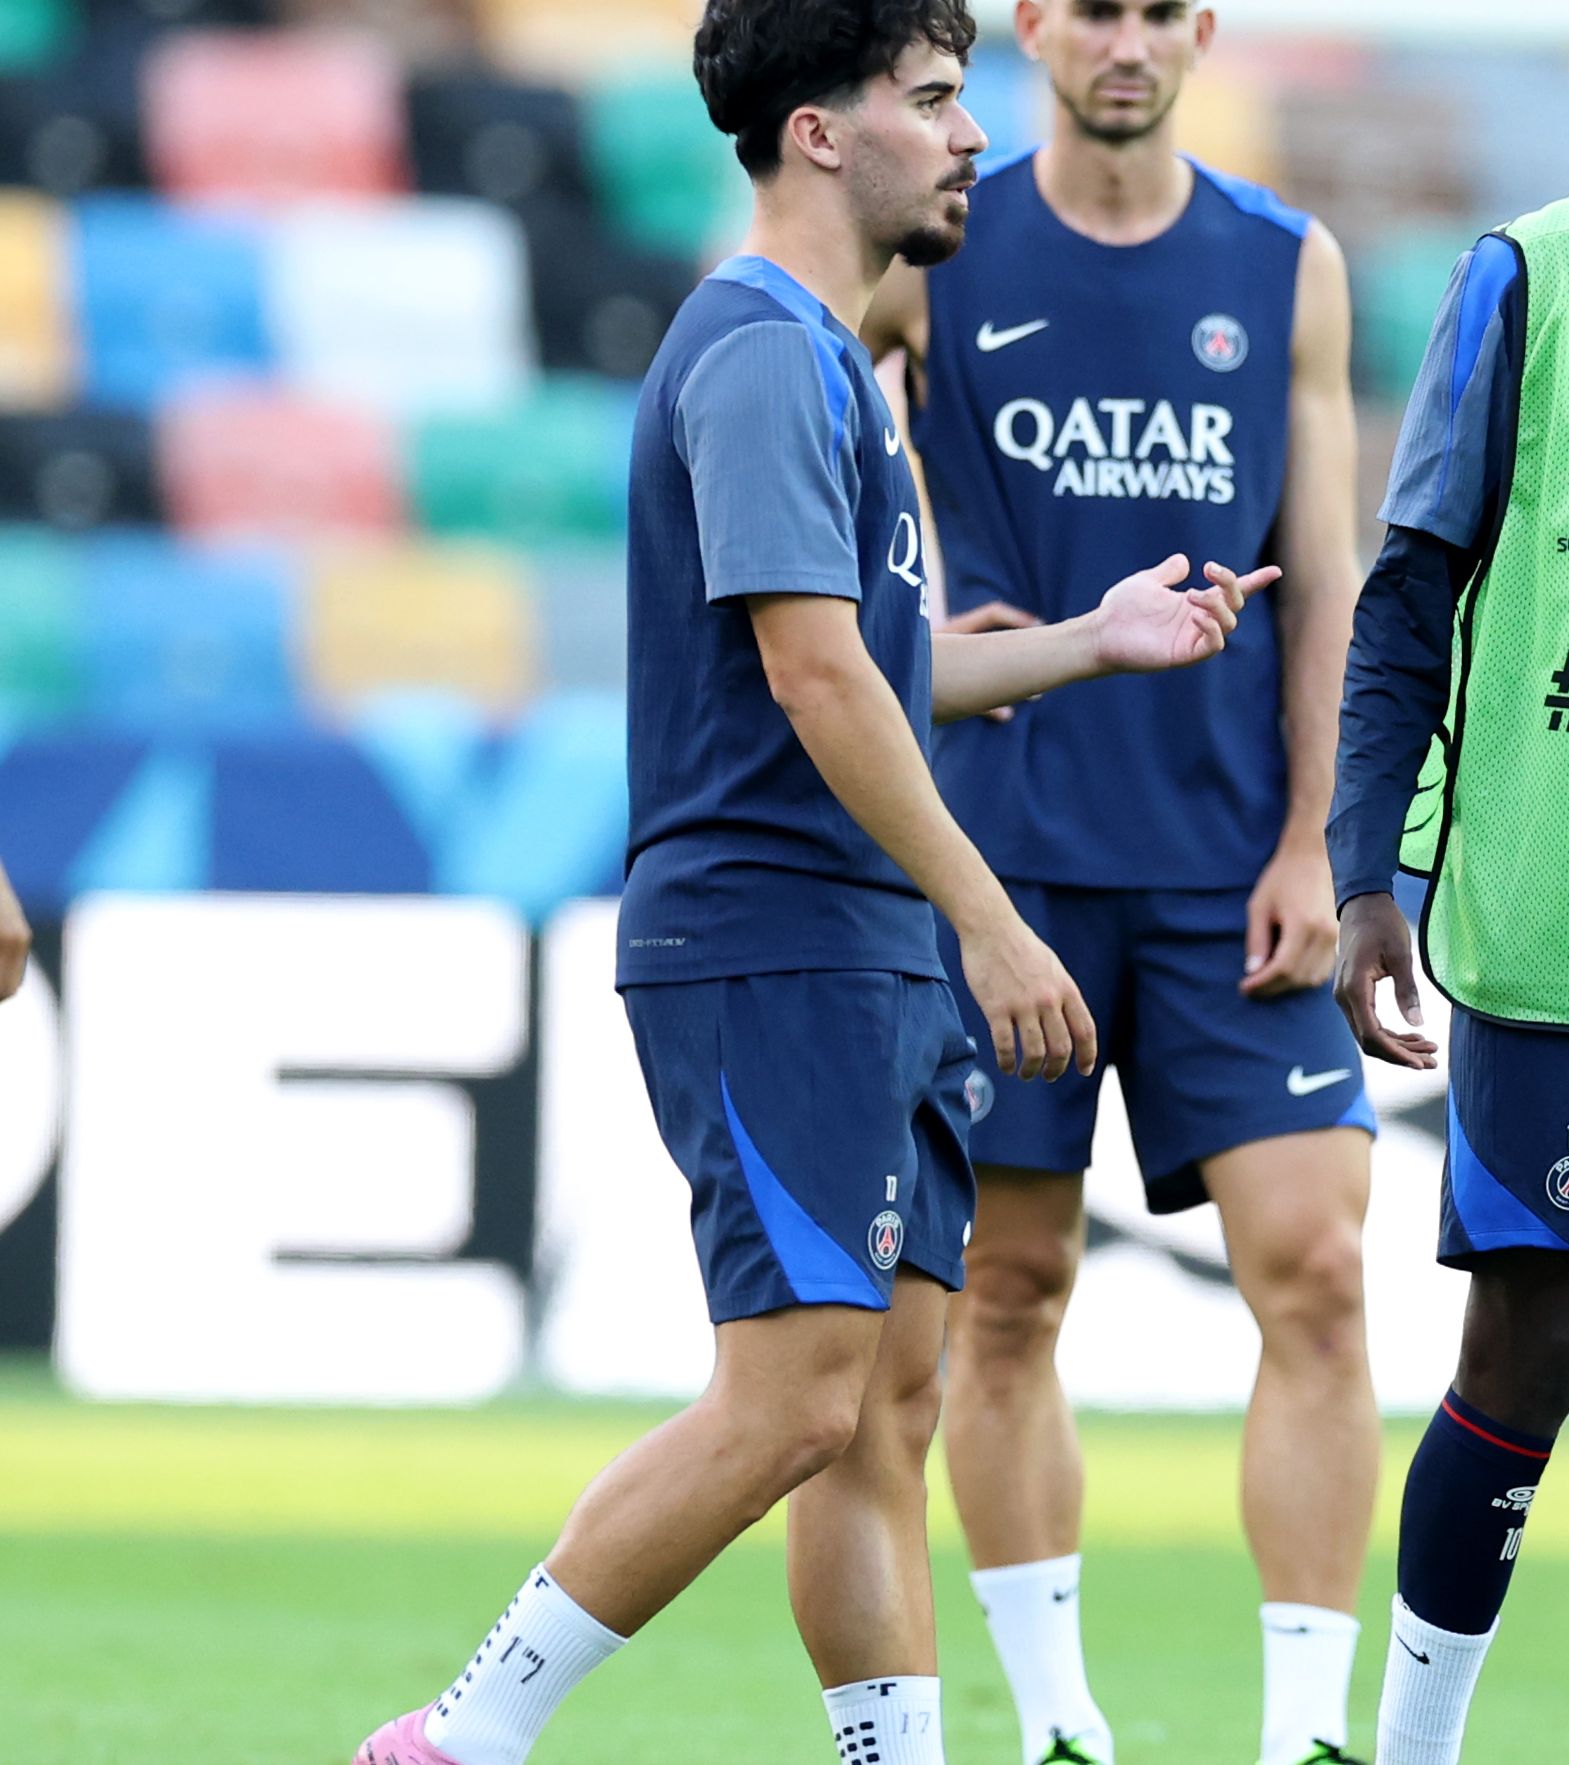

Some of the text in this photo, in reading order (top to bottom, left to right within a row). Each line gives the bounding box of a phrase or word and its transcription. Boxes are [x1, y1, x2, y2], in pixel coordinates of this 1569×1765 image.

[994, 397, 1234, 471] QATAR
[1053, 457, 1235, 505] AIRWAYS
[1499, 1526, 1523, 1561] 10
